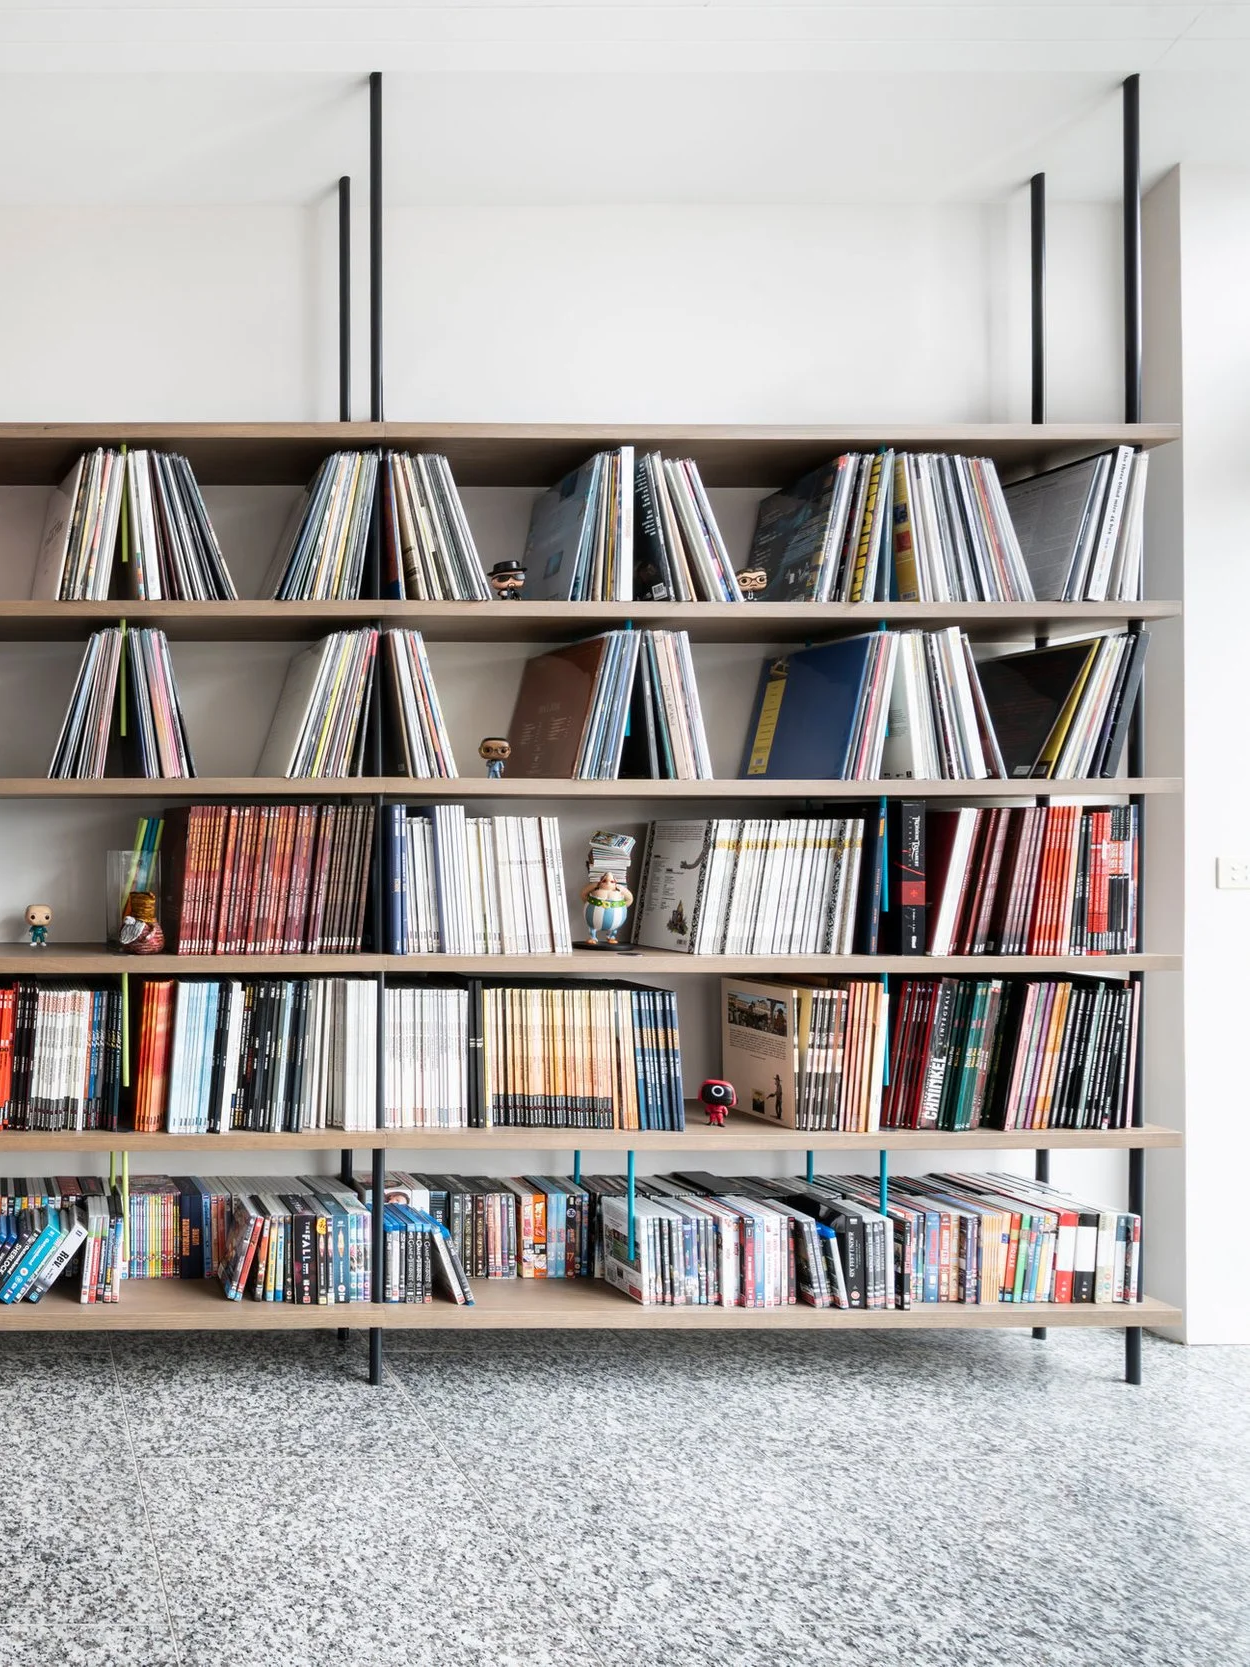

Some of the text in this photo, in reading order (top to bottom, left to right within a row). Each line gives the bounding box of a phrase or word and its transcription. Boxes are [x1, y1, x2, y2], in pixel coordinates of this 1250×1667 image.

[52, 1250, 70, 1268] Rev.
[302, 1233, 311, 1262] FALL
[1010, 1242, 1018, 1267] HOUSE
